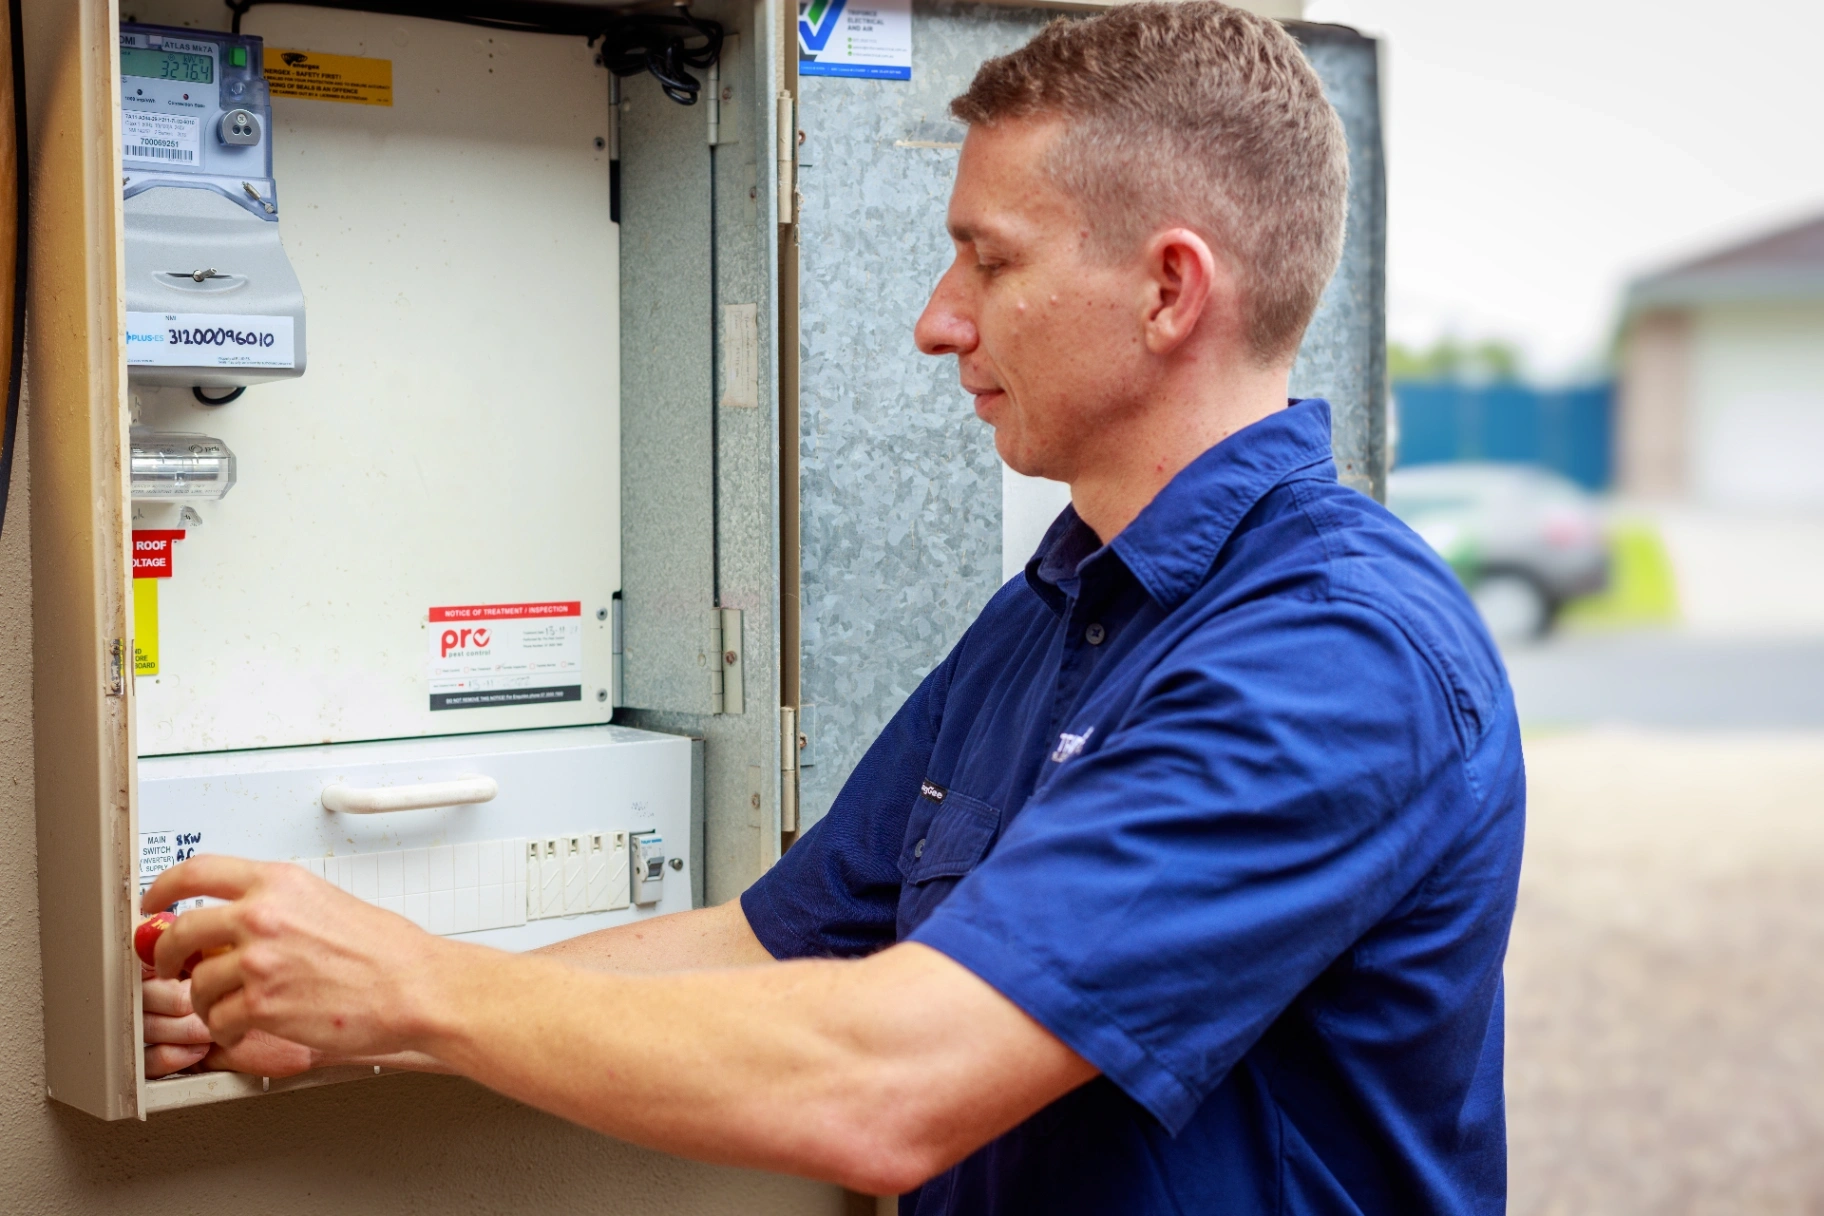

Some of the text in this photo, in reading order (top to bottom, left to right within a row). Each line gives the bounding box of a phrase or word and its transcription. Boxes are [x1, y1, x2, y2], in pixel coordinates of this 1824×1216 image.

[848, 17, 884, 25] ELECTRICAL
[164, 41, 191, 51] ATLAS
[136, 540, 167, 551] ROOF
[445, 609, 470, 617] NOTICE
[472, 608, 482, 616] OF
[483, 607, 523, 616] TREATMENT
[528, 605, 569, 614] INSPECTION
[441, 628, 491, 658] pro
[466, 649, 491, 657] control
[147, 835, 166, 845] MAIN
[142, 846, 171, 856] SWITCH
